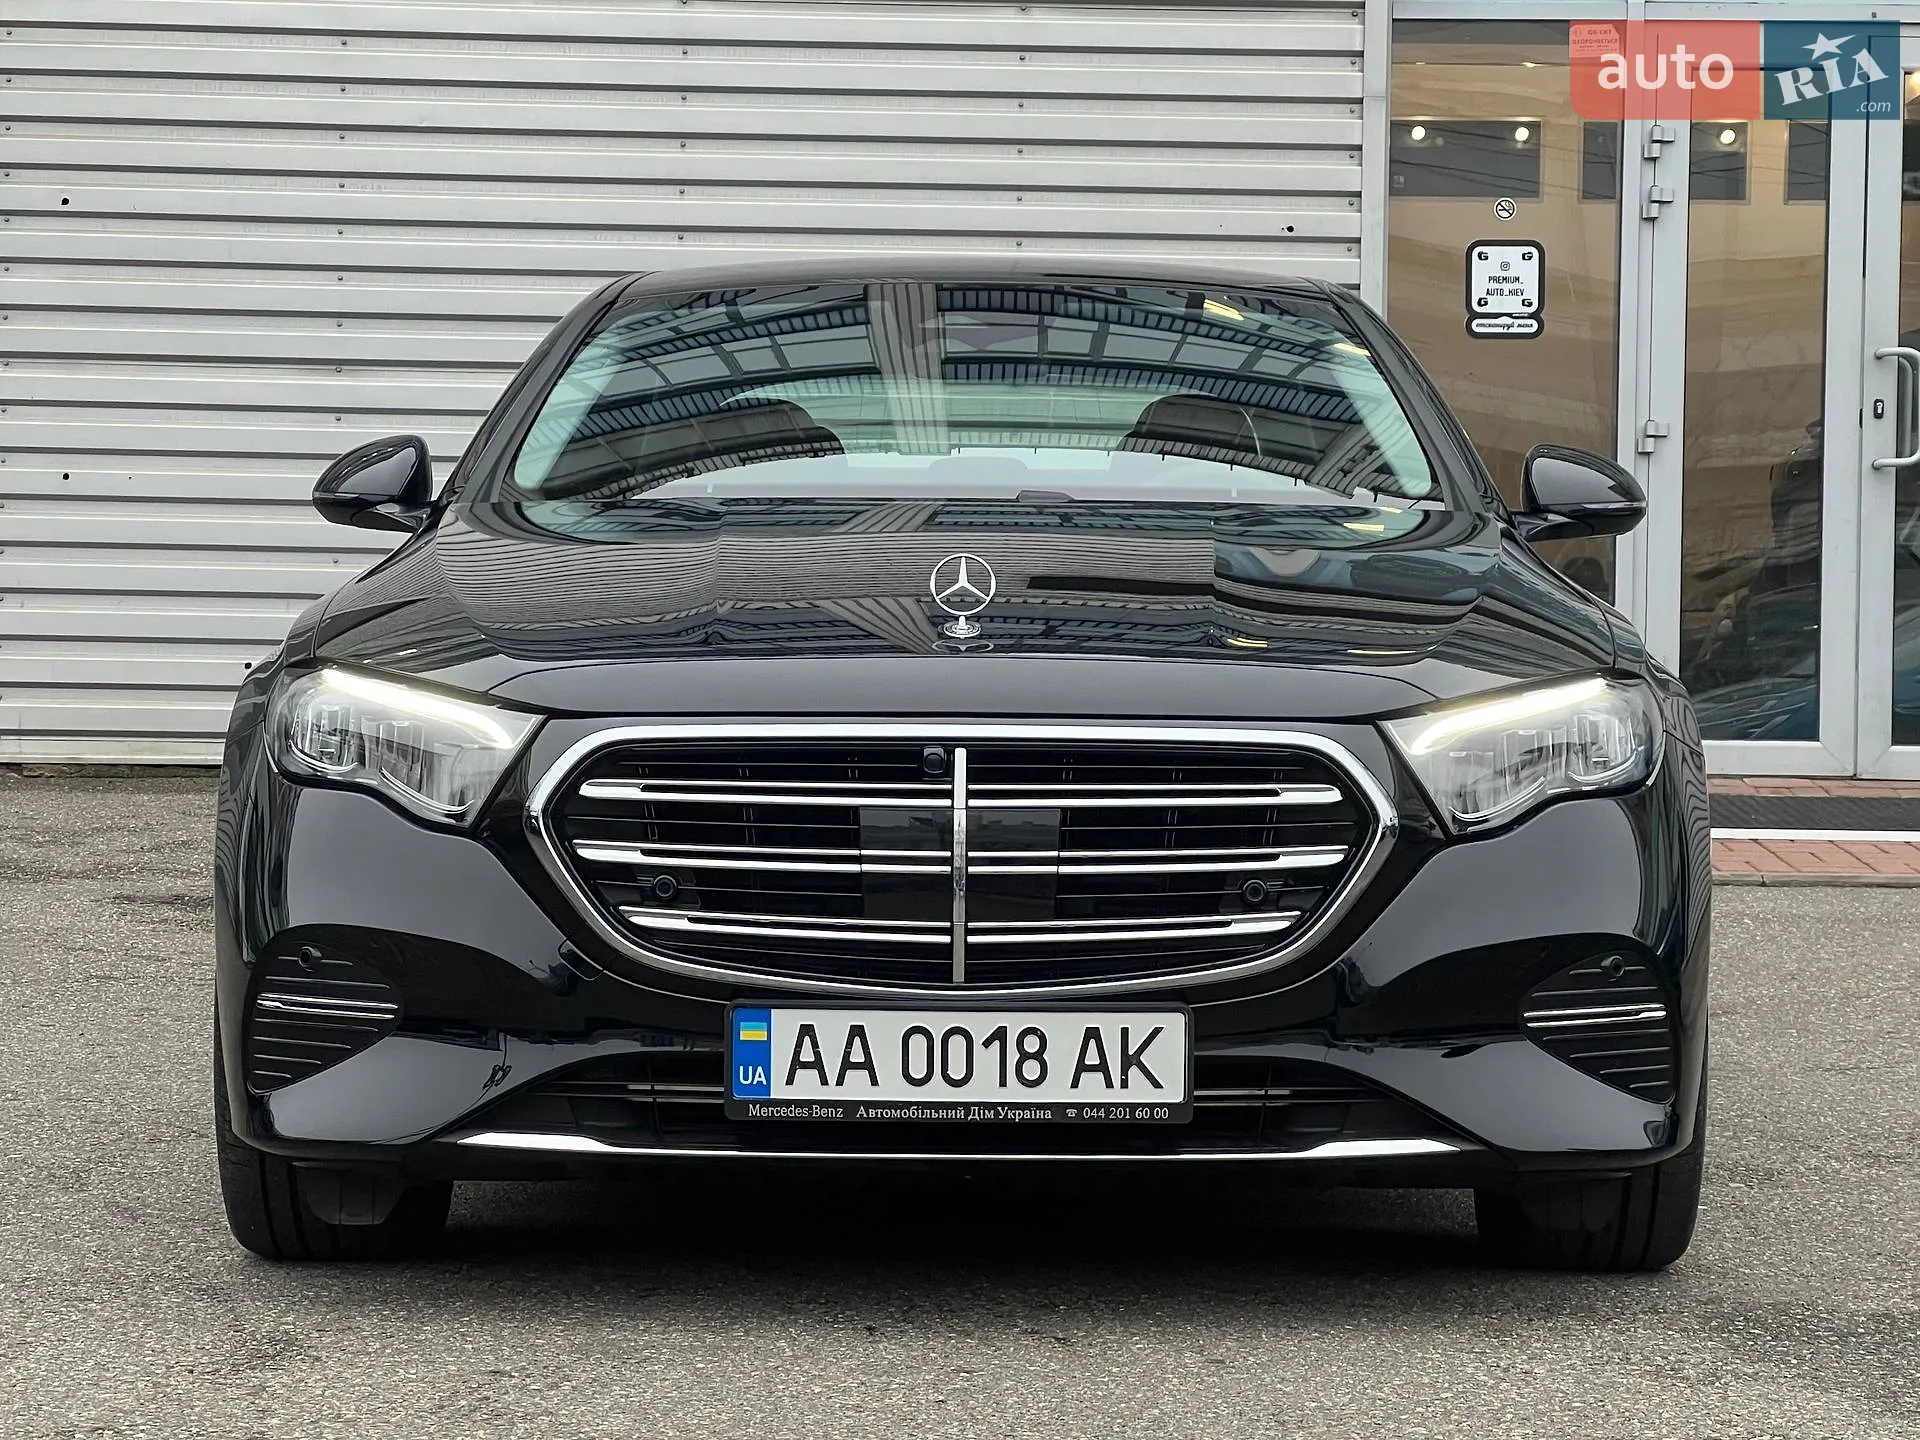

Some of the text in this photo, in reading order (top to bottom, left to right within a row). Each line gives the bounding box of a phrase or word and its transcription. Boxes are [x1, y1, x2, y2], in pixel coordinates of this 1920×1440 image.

[1486, 288, 1524, 297] AUTO_KIEV
[784, 1023, 1166, 1090] AA 0018 AK
[739, 1066, 767, 1085] UA
[749, 1104, 844, 1118] Mercedes-Benz
[856, 1105, 1052, 1121] Автомобільний Дім Україна
[1083, 1108, 1169, 1119] 044 201 60 00
